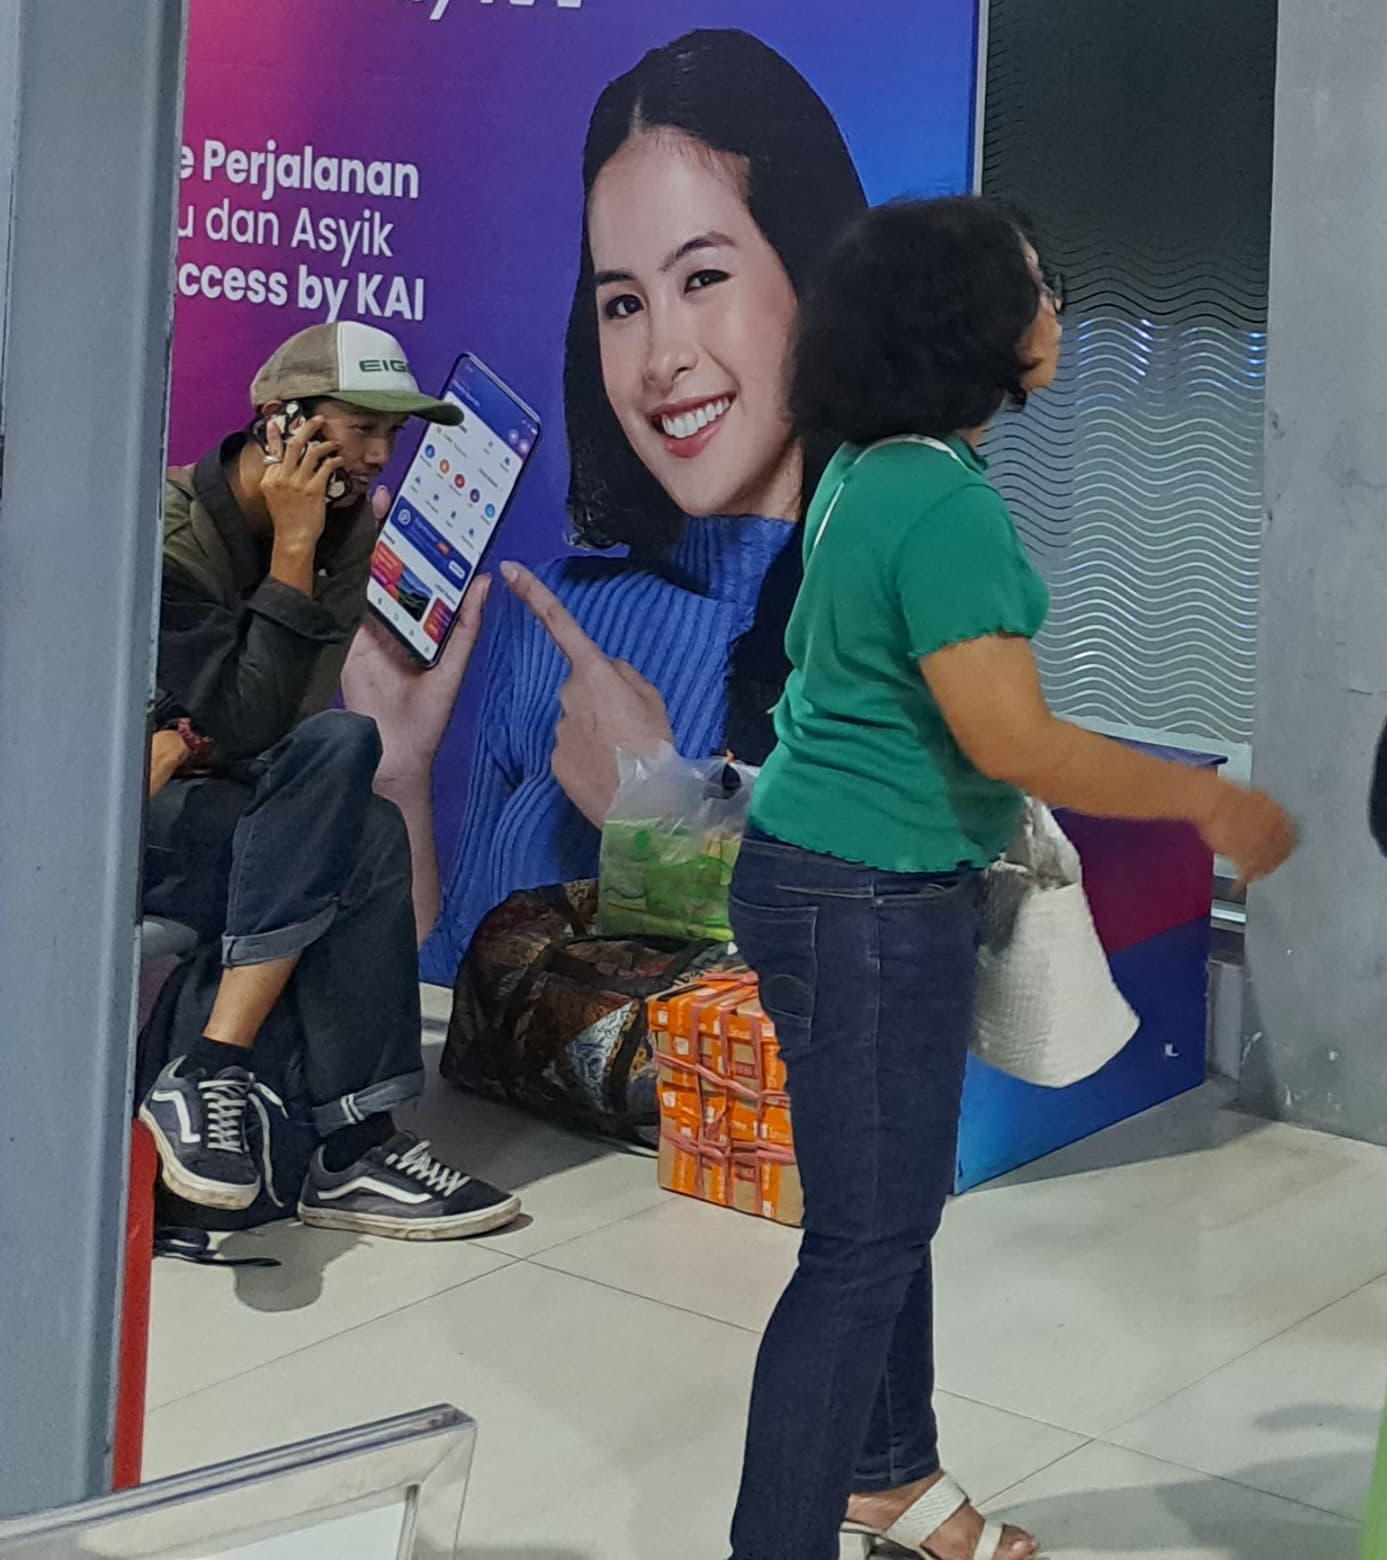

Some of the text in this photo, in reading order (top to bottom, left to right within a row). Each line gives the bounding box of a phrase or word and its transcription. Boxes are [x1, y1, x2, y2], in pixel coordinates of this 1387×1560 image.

[203, 139, 420, 200] Perjalanan
[206, 199, 279, 246] dan
[291, 207, 394, 267] Asyik
[177, 262, 425, 322] ccess by KAI
[359, 359, 412, 374] EIG
